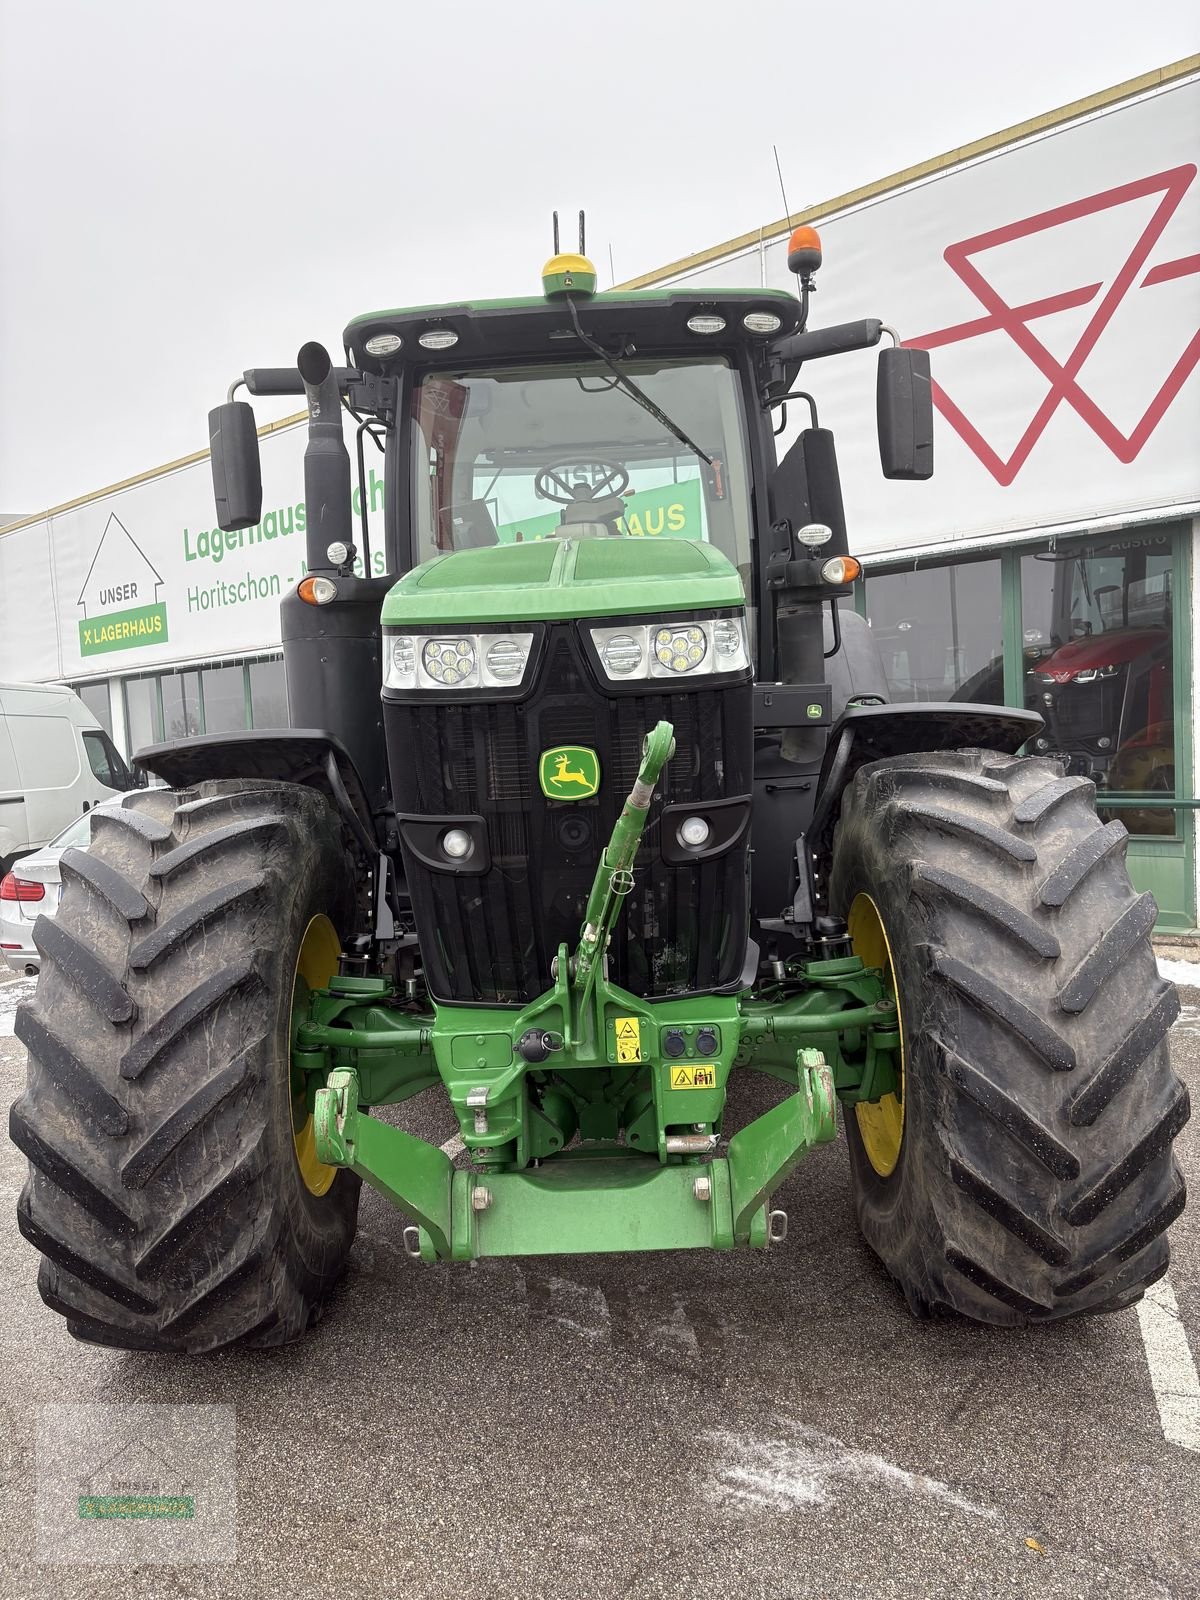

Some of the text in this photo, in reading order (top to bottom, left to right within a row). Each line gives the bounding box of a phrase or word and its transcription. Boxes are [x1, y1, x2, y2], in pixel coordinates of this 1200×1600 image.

[100, 582, 138, 605] UNSER
[187, 571, 281, 612] Horitschon
[94, 615, 162, 644] LAGERHAUS
